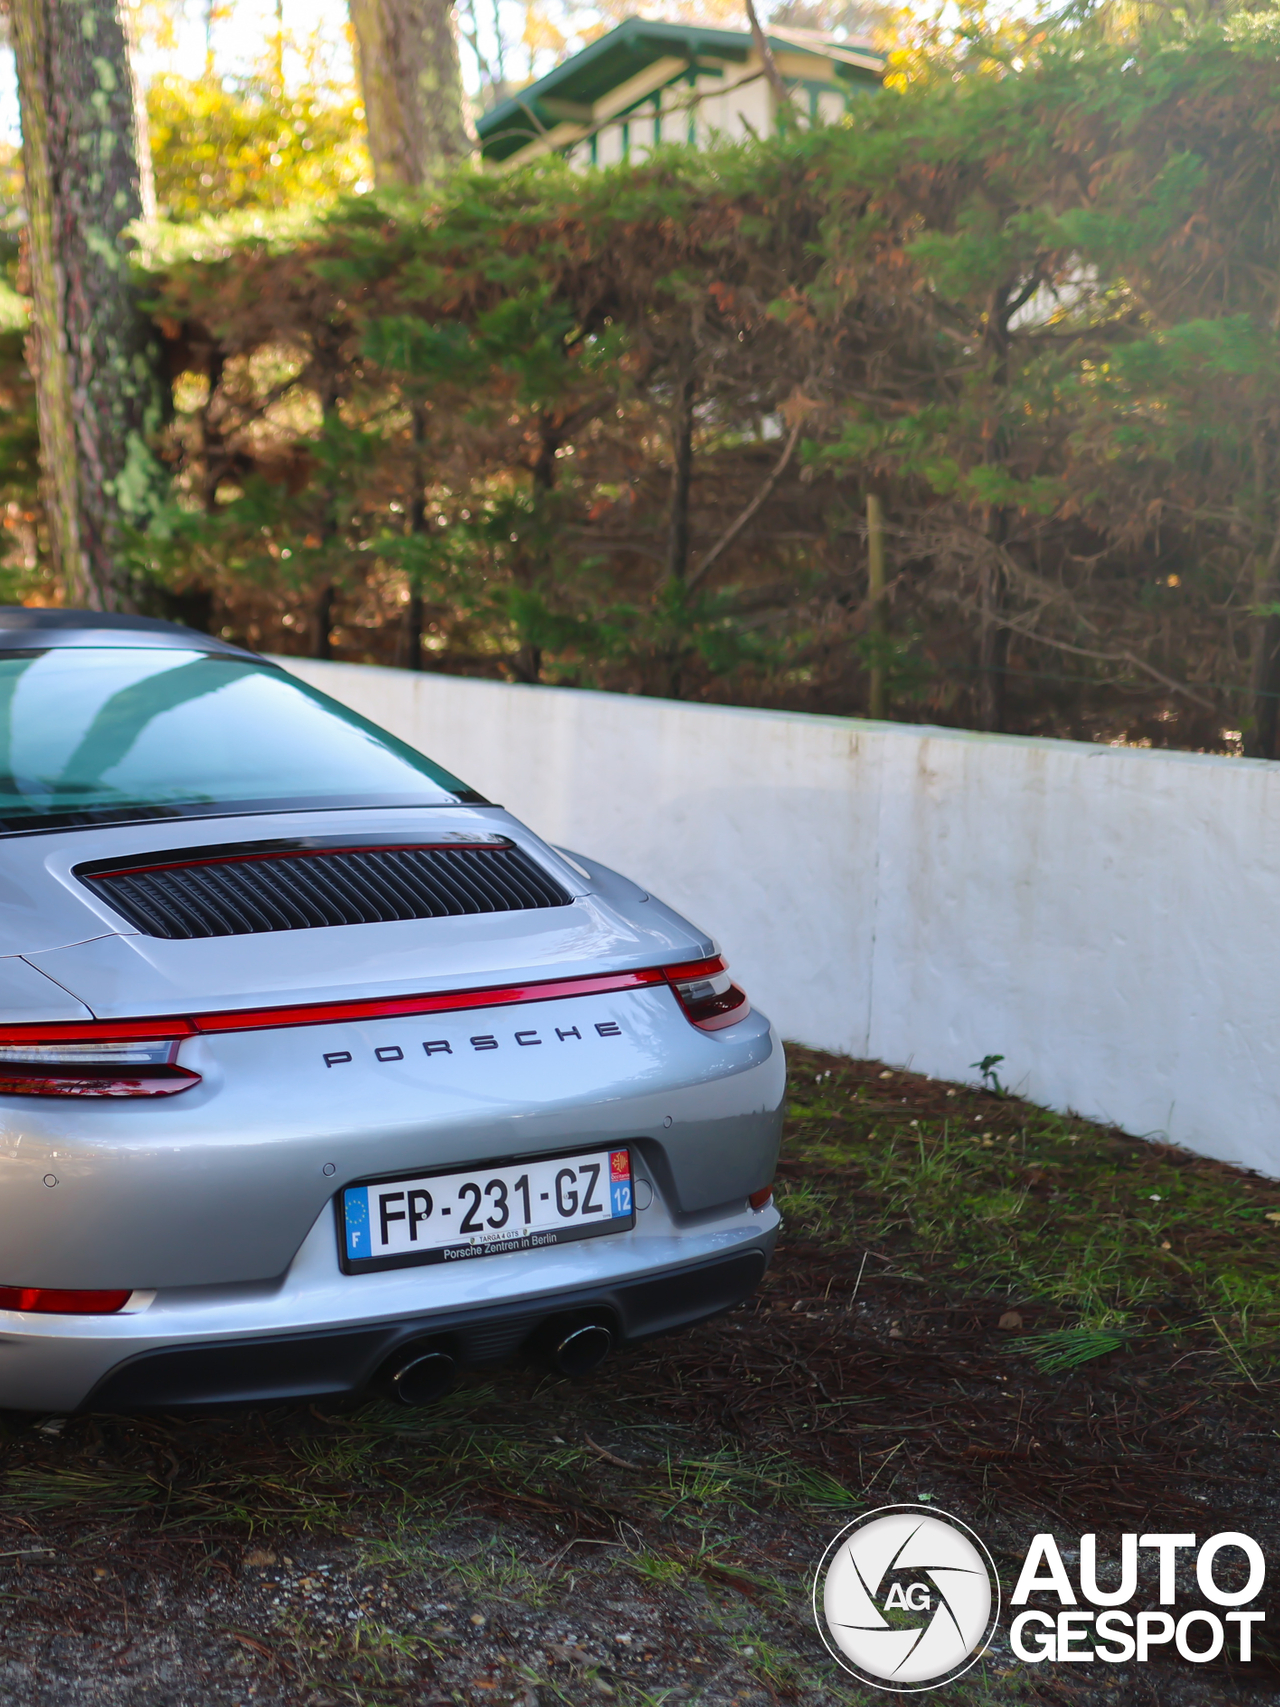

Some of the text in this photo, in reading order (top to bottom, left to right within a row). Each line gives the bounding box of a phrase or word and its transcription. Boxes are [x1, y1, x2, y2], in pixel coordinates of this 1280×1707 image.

[323, 1021, 622, 1068] PORSCHE
[378, 1163, 604, 1245] FP-231-GZ
[614, 1186, 632, 1212] 12
[351, 1231, 361, 1248] F
[443, 1233, 557, 1259] Porsche Zentren in Berlin
[479, 1233, 501, 1243] TARGA
[506, 1230, 519, 1238] GTS
